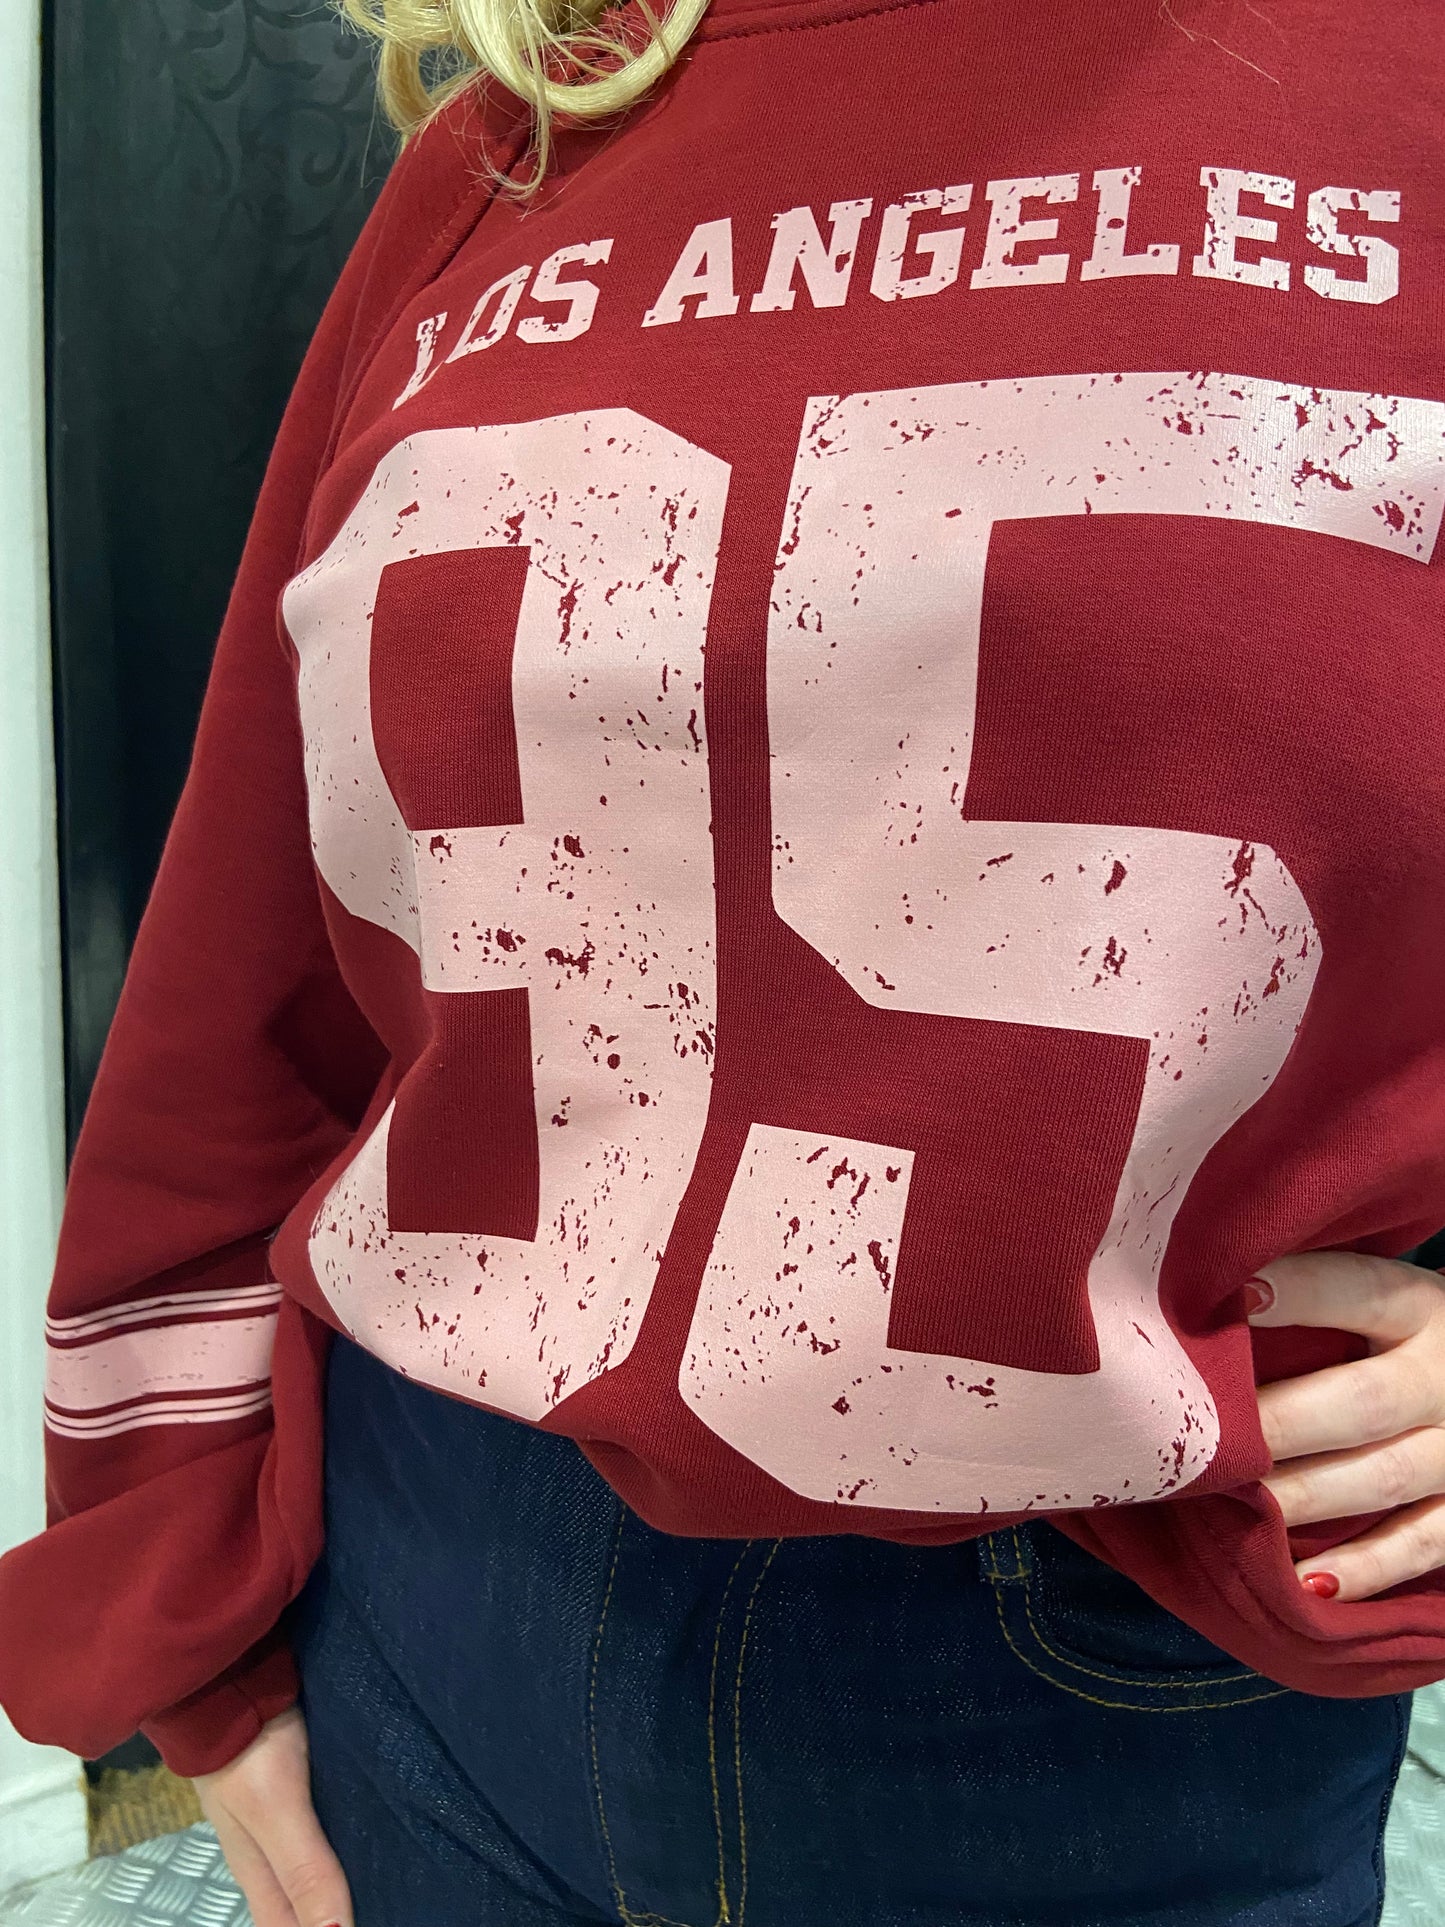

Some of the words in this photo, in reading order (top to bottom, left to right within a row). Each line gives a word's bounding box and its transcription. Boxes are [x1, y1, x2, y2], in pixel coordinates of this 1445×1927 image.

[392, 238, 614, 411] LOS
[641, 166, 1402, 328] ANGELES
[282, 371, 1445, 1514] 95
